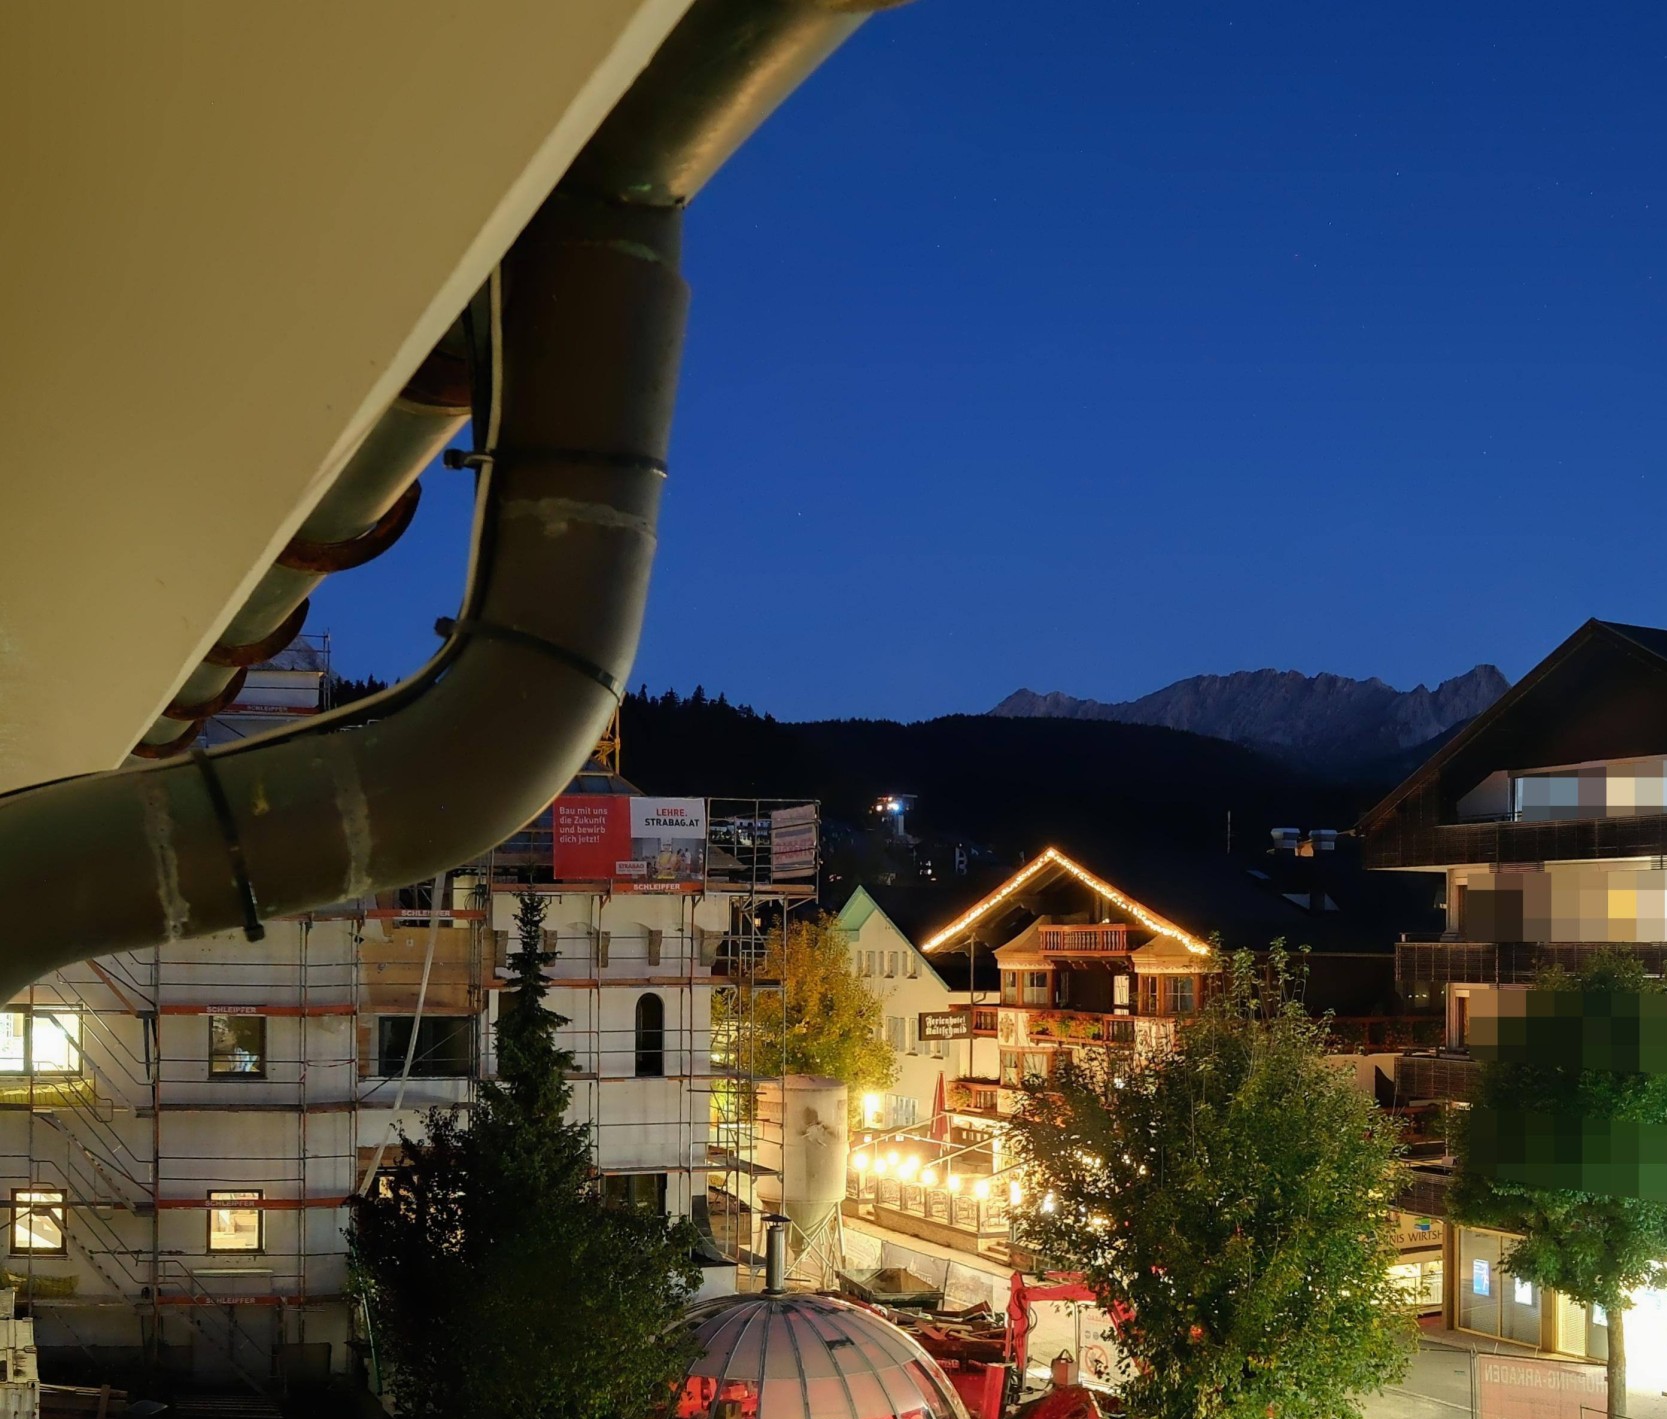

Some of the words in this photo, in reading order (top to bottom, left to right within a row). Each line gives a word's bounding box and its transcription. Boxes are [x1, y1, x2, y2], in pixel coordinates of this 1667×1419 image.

[560, 807, 576, 815] Bau
[577, 807, 592, 815] mit
[656, 808, 688, 817] LEHRE.
[560, 816, 572, 825] die
[574, 816, 606, 825] Zukunft
[645, 818, 700, 828] STRABAG.AT
[560, 826, 574, 834] und
[577, 826, 606, 835] bewirb
[560, 835, 576, 843] dich
[578, 835, 600, 845] jetzt!
[633, 883, 681, 891] SCHLEIPFER
[401, 909, 451, 917] SCHLEFER
[206, 1005, 257, 1014] SCHLEIPFER
